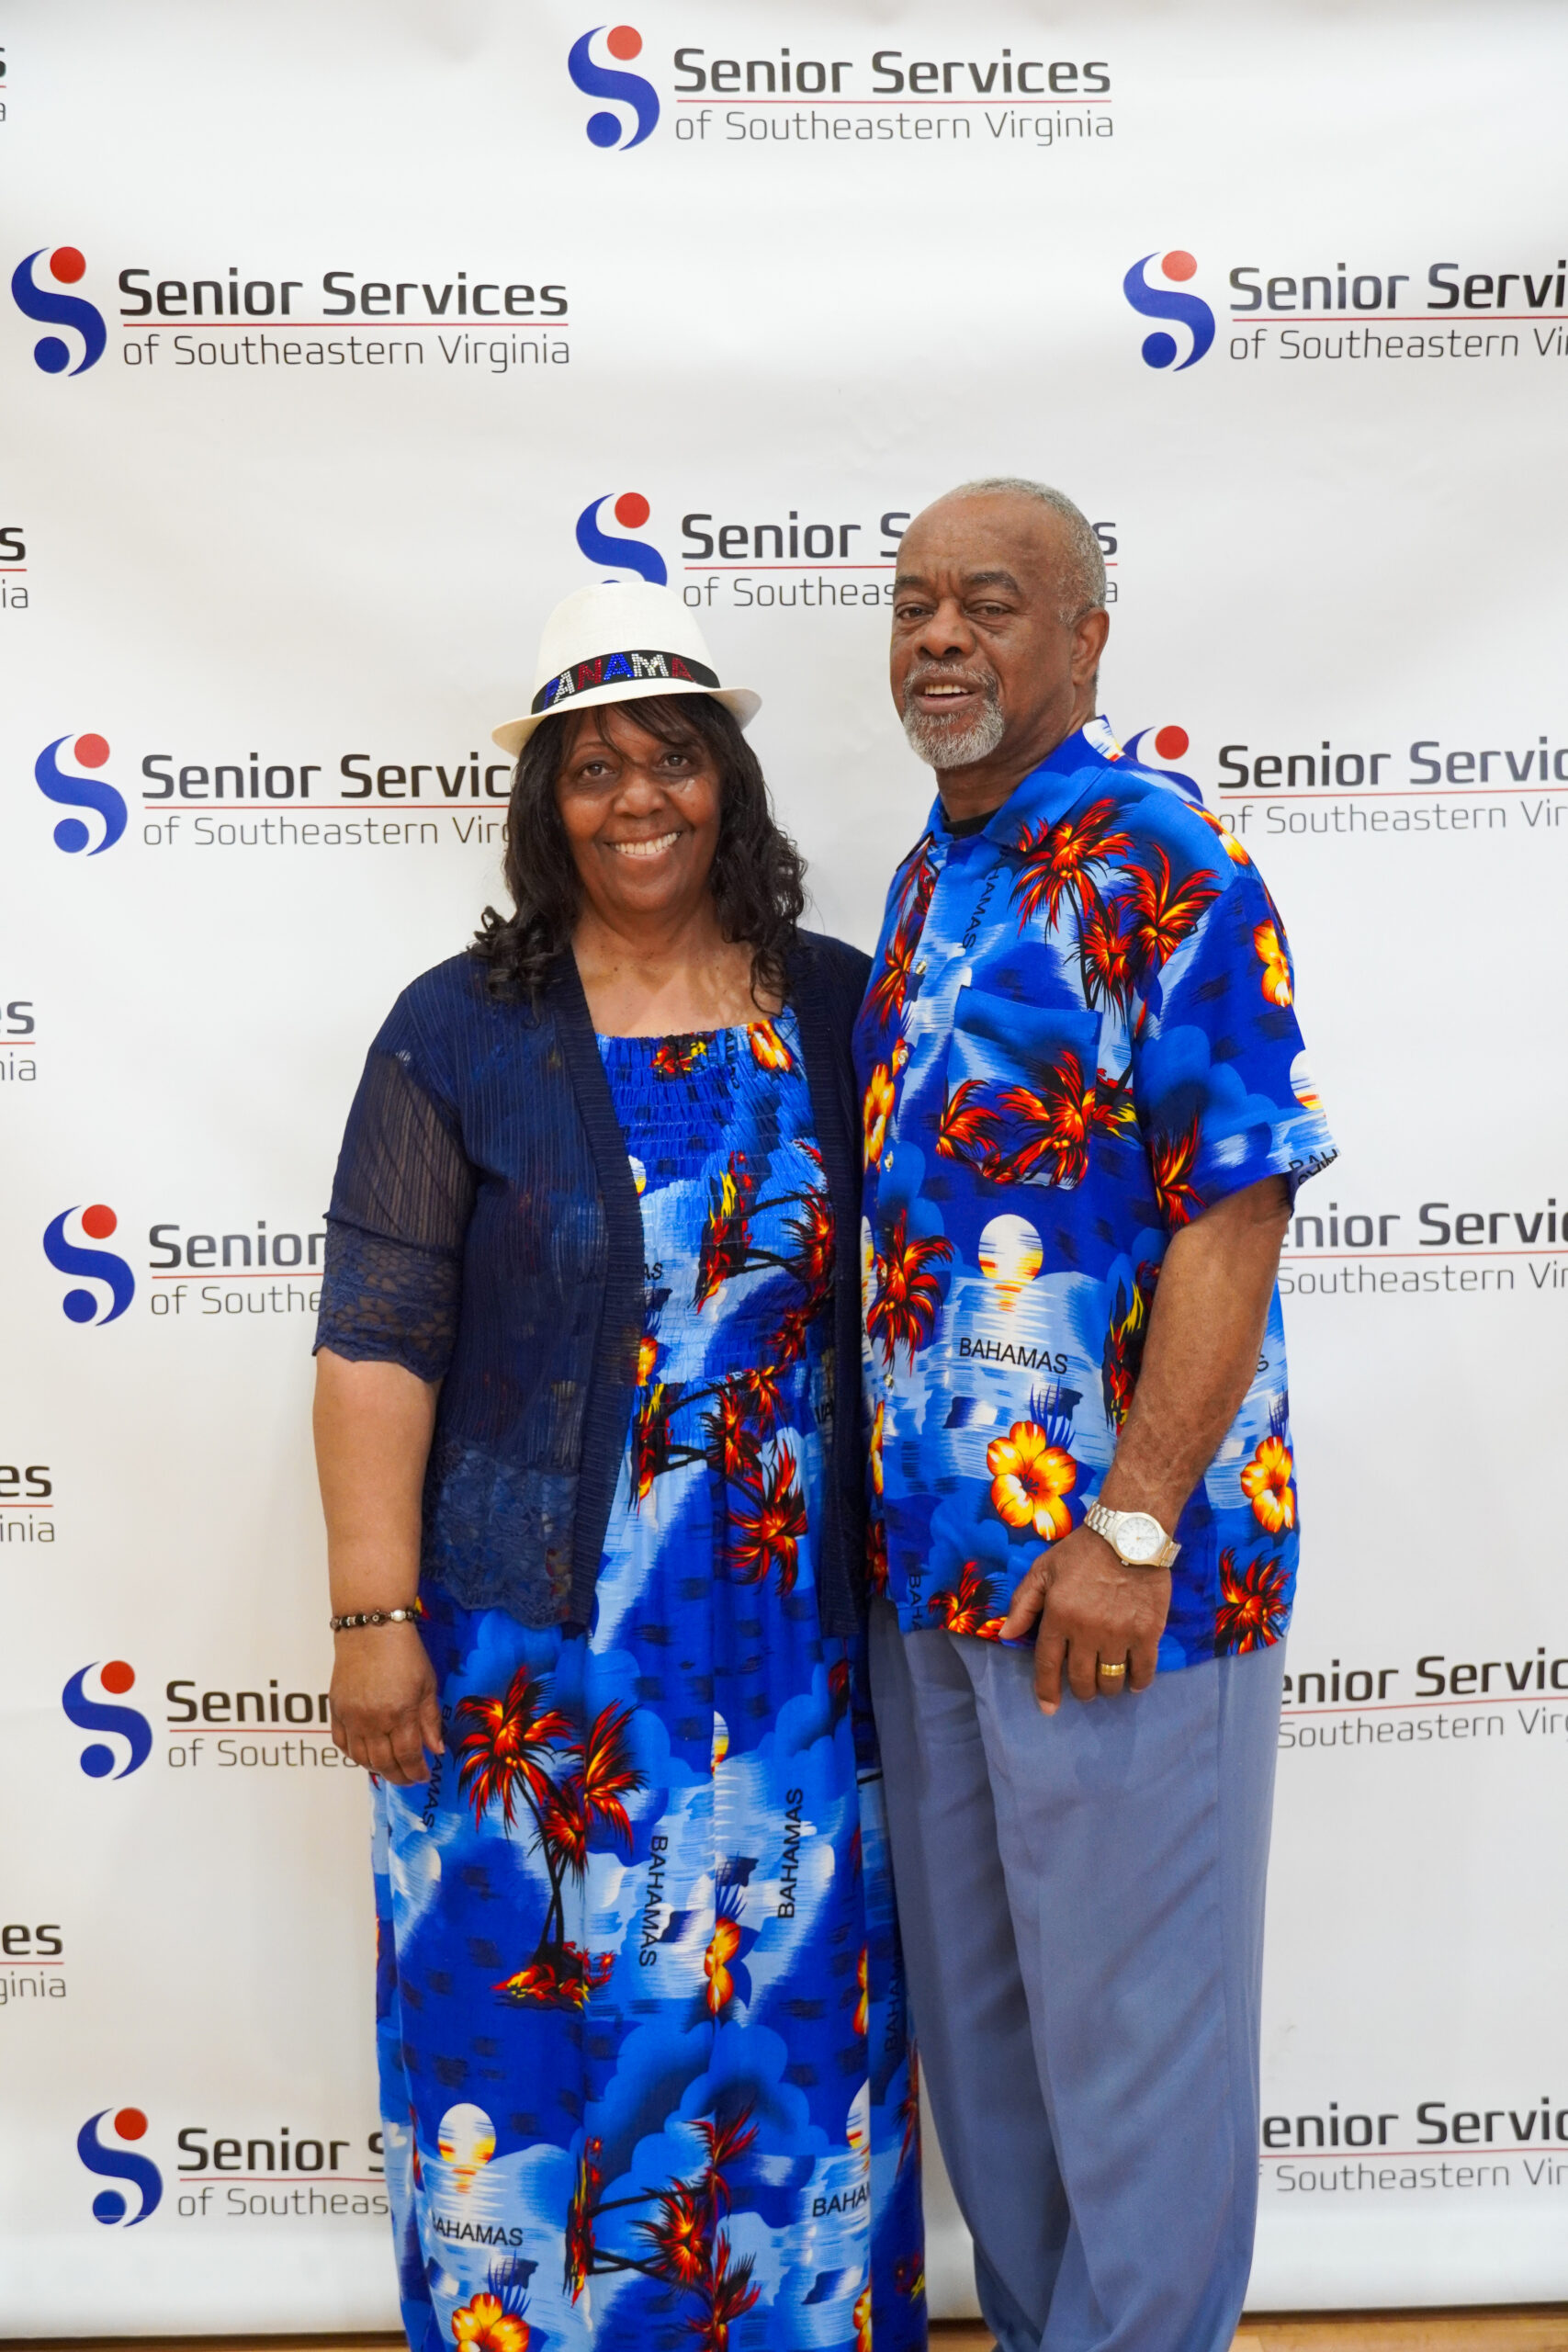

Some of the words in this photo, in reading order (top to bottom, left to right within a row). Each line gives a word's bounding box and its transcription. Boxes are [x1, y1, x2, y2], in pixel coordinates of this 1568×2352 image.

[673, 47, 853, 93] Senior
[871, 49, 1111, 94] Services
[675, 110, 713, 141] of
[726, 107, 970, 140] Southeastern
[984, 109, 1113, 147] Virginia
[118, 266, 304, 317] Senior
[322, 271, 569, 317] Services
[1229, 262, 1410, 311] Senior
[1427, 259, 1567, 311] Servi
[123, 333, 161, 366] of
[174, 334, 423, 366] Southeastern
[437, 333, 570, 374] Virginia
[1229, 328, 1269, 360] of
[1280, 328, 1519, 360] Southeastern
[681, 510, 862, 560] Senior
[682, 576, 720, 606] of
[542, 652, 697, 708] PANAMA
[141, 752, 322, 798] Senior
[1217, 741, 1392, 789] Senior
[143, 815, 181, 846] of
[194, 815, 438, 845] Southeastern
[1266, 803, 1506, 834] Southeastern
[148, 1220, 326, 1267] Senior
[1277, 1264, 1515, 1295] Southeastern
[151, 1284, 188, 1316] of
[958, 1337, 1068, 1374] BAHAMAS
[1278, 1716, 1504, 1748] Southeastern
[168, 1737, 205, 1768] of
[777, 1788, 804, 1919] BAHAMAS
[638, 1836, 669, 1967] BAHAMAS
[176, 2126, 351, 2172] Senior
[1276, 2162, 1509, 2192] Southeastern
[177, 2187, 214, 2217] of
[227, 2187, 389, 2216] Southeas
[812, 2181, 870, 2218] BAHA
[432, 2209, 524, 2247] AHAMAS
